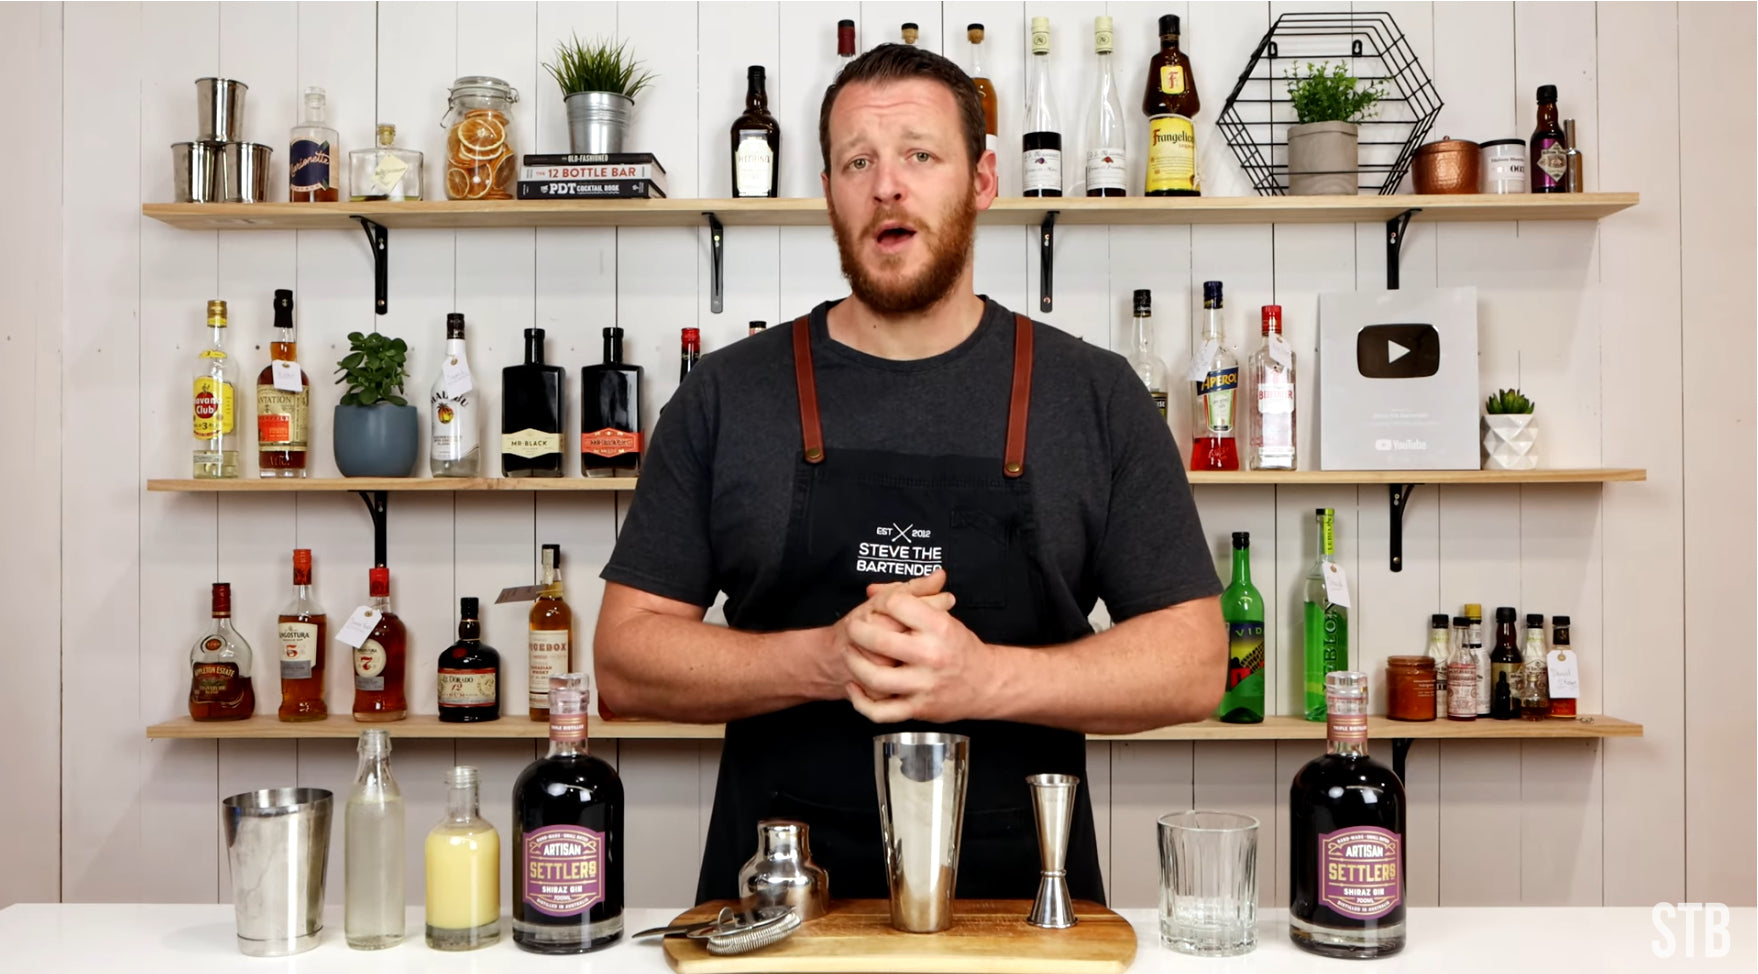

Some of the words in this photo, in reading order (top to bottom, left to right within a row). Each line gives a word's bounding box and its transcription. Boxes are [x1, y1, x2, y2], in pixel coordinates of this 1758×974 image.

[568, 155, 609, 163] OLD-FASHIONED
[548, 169, 559, 178] 12
[562, 167, 607, 178] BOTTLE
[611, 167, 636, 177] BAR
[549, 183, 577, 195] PDT
[576, 185, 603, 193] COCKTAIL
[604, 184, 620, 192] BOOK
[195, 397, 221, 405] avana
[196, 405, 214, 414] Club
[1391, 438, 1427, 450] YouTube
[876, 526, 893, 536] EST
[911, 529, 931, 538] 2012
[858, 542, 910, 559] STEVE
[912, 546, 942, 560] THE
[1236, 627, 1264, 637] VID
[286, 644, 298, 658] 5
[360, 656, 373, 671] 7
[543, 843, 582, 856] ARTISAN
[1345, 844, 1384, 858] ARTISAN
[530, 860, 597, 880] SETTLERS
[1328, 862, 1396, 882] SETTLERS
[542, 885, 568, 894] SHIRAZ
[570, 885, 583, 893] GIN
[1343, 887, 1371, 896] SHIRAZ
[1373, 887, 1385, 896] GIN
